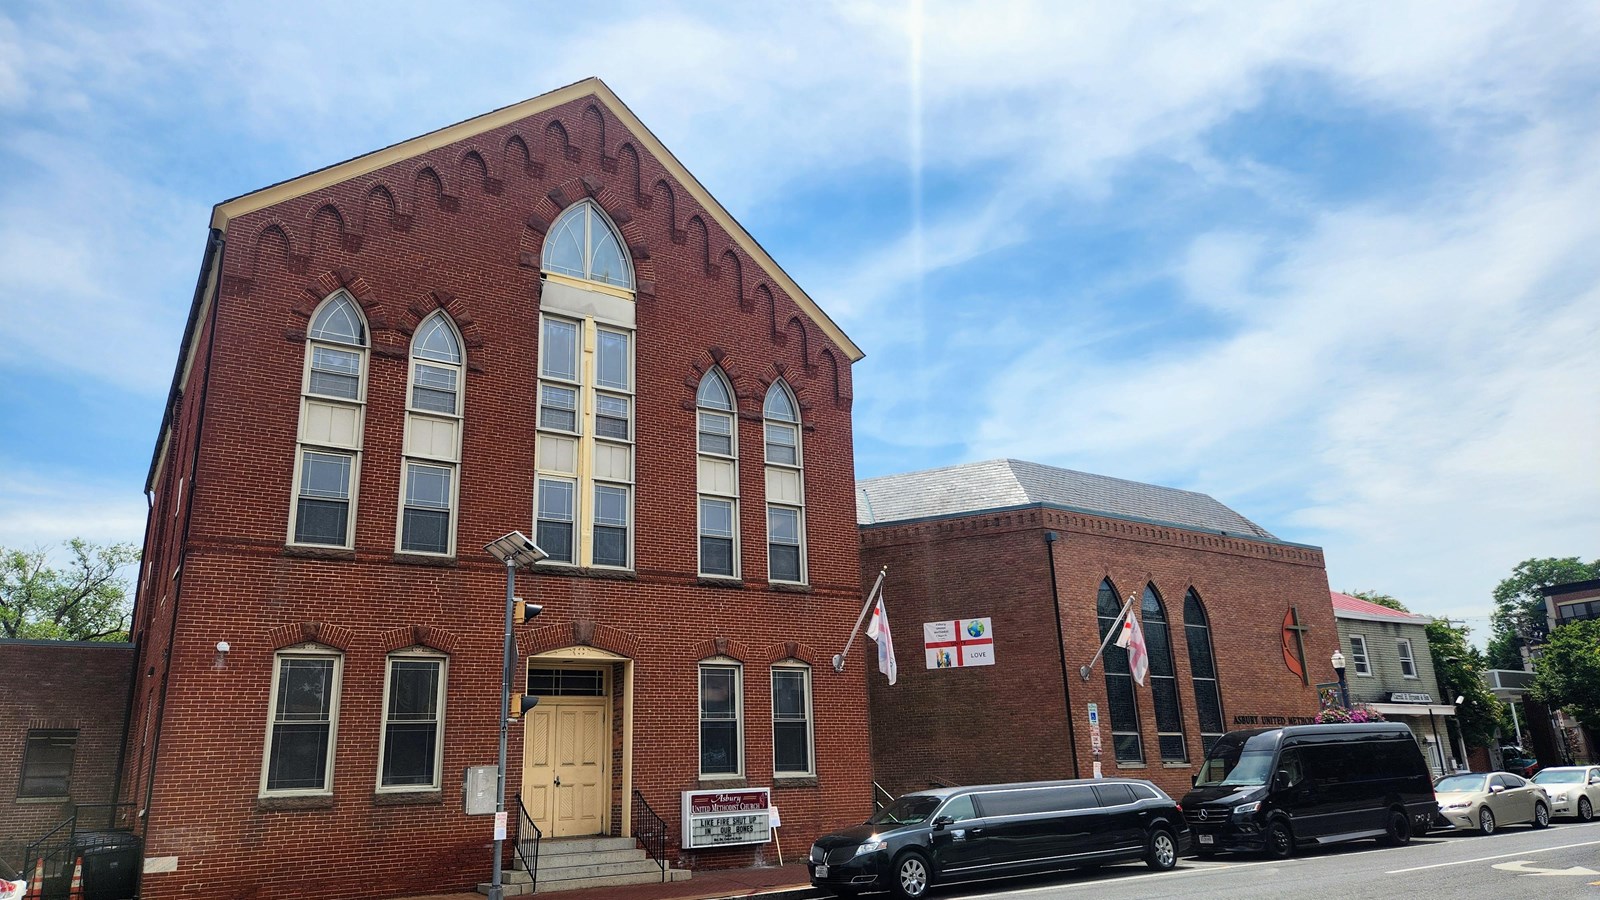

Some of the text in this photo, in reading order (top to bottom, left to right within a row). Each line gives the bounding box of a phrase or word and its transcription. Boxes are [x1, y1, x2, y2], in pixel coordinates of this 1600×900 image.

[1234, 715, 1258, 724] ASBURY
[1261, 716, 1285, 725] UNITED
[711, 794, 741, 803] Asbury
[701, 819, 714, 827] LIKE
[717, 818, 730, 826] FIRE
[736, 825, 753, 833] BONES
